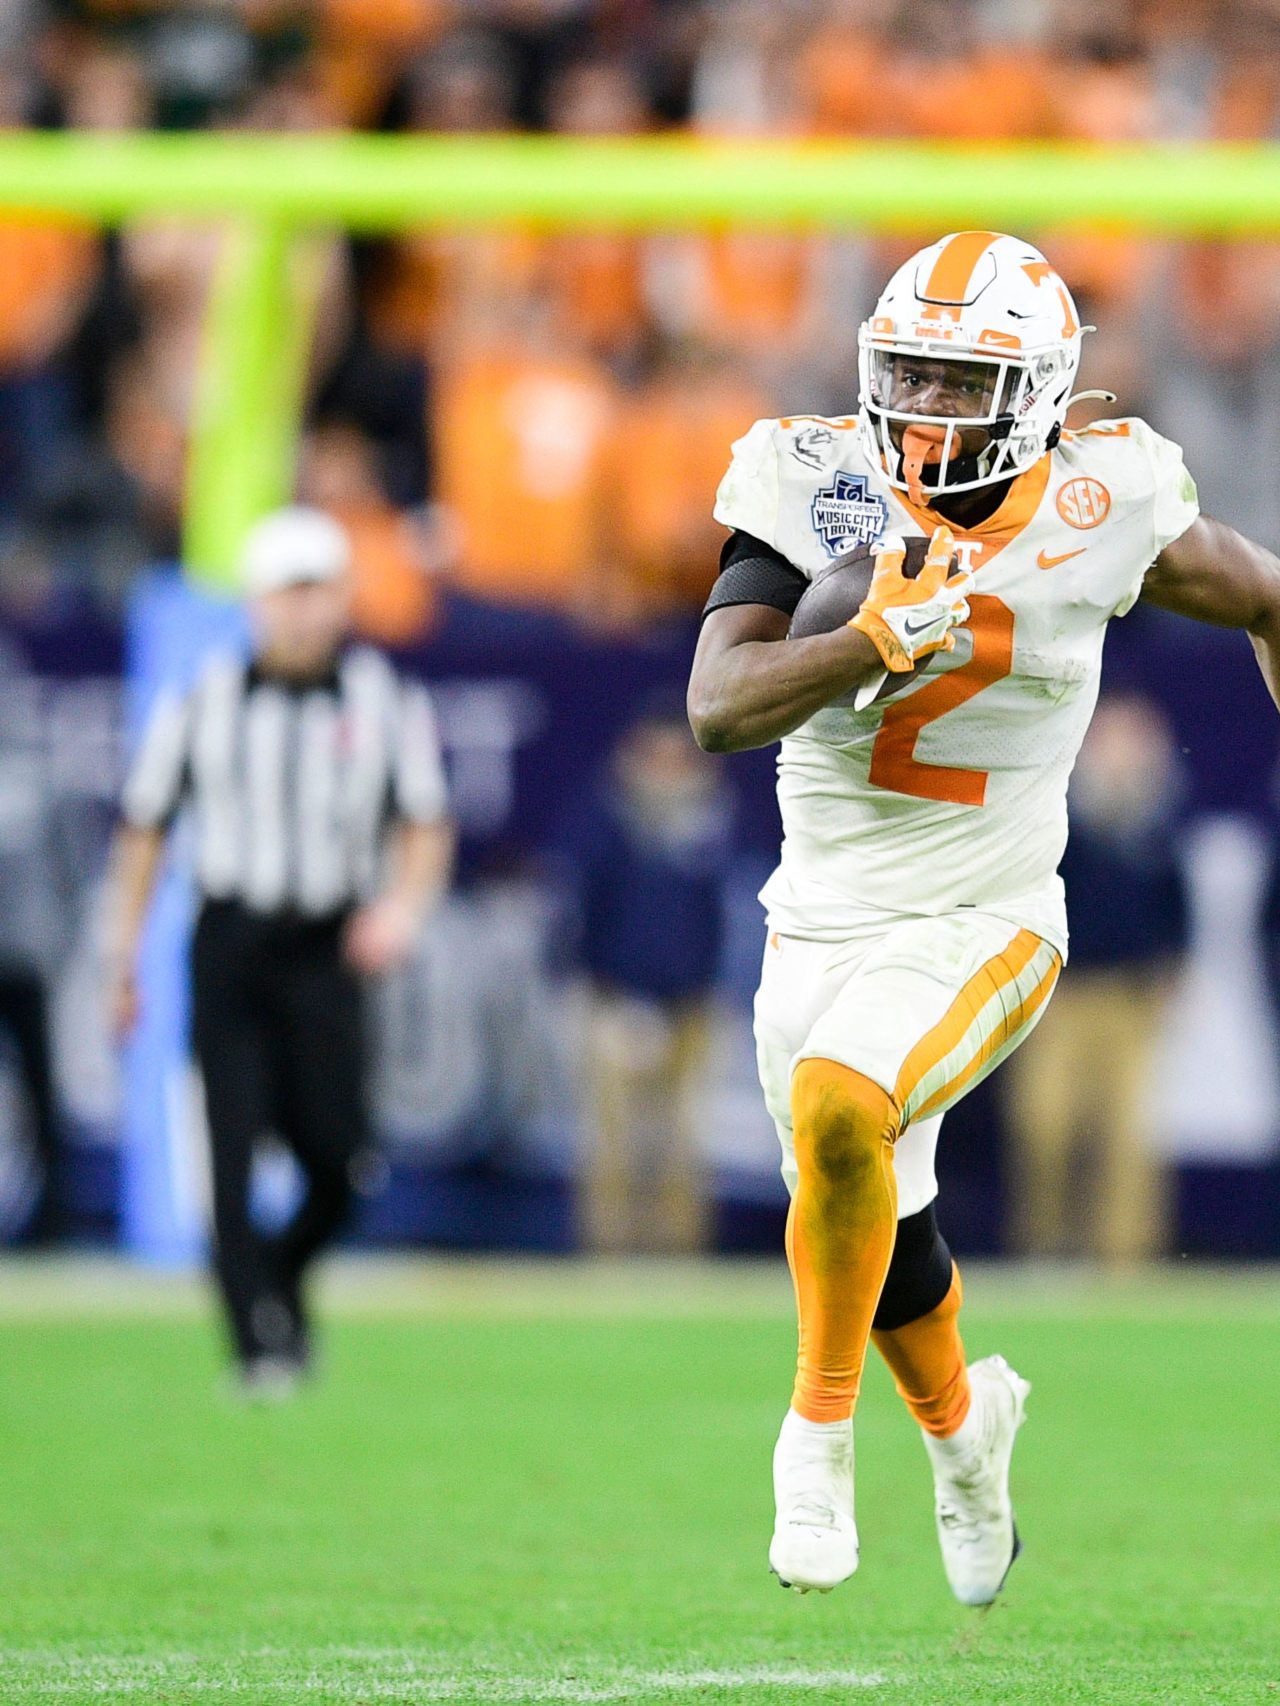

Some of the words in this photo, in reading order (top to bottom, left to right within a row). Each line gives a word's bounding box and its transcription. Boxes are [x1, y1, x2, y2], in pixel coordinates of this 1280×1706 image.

[817, 500, 880, 514] TRANSPERFECT
[1058, 479, 1110, 527] SEC
[816, 510, 852, 526] MUSIC
[853, 514, 882, 531] CITY
[830, 525, 865, 538] BOWL
[953, 541, 983, 574] T
[868, 593, 1015, 807] 2
